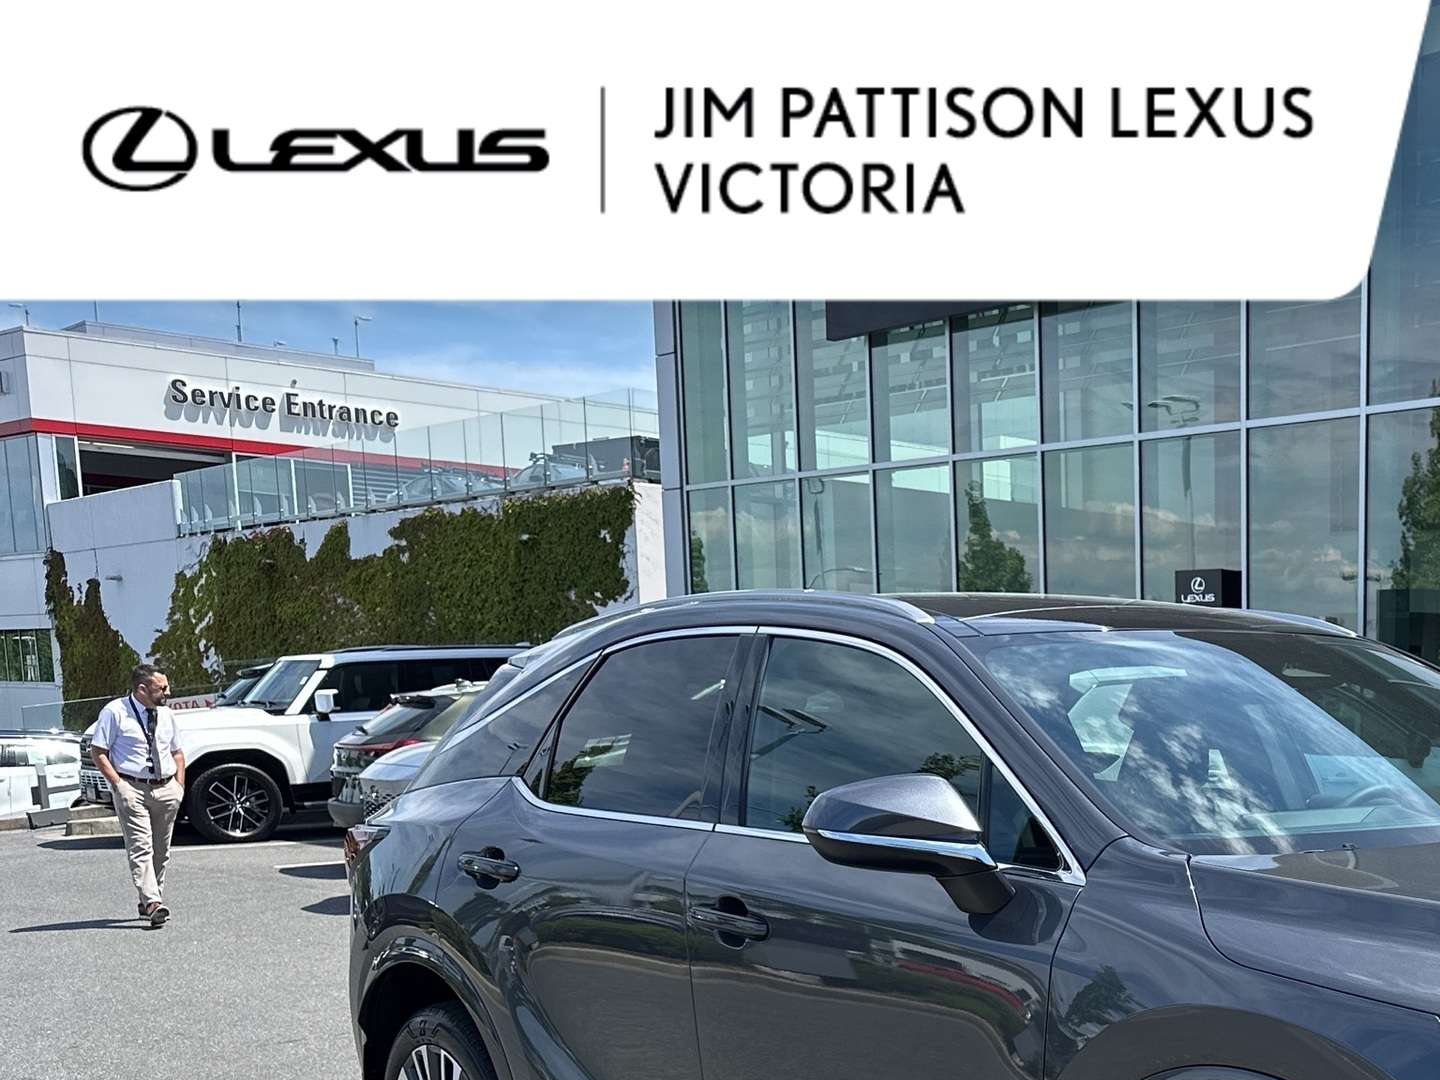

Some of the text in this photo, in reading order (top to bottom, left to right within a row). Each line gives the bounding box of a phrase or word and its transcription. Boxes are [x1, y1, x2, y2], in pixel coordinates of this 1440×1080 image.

[171, 379, 400, 428] Service Entrance
[1181, 593, 1216, 603] LEXUS
